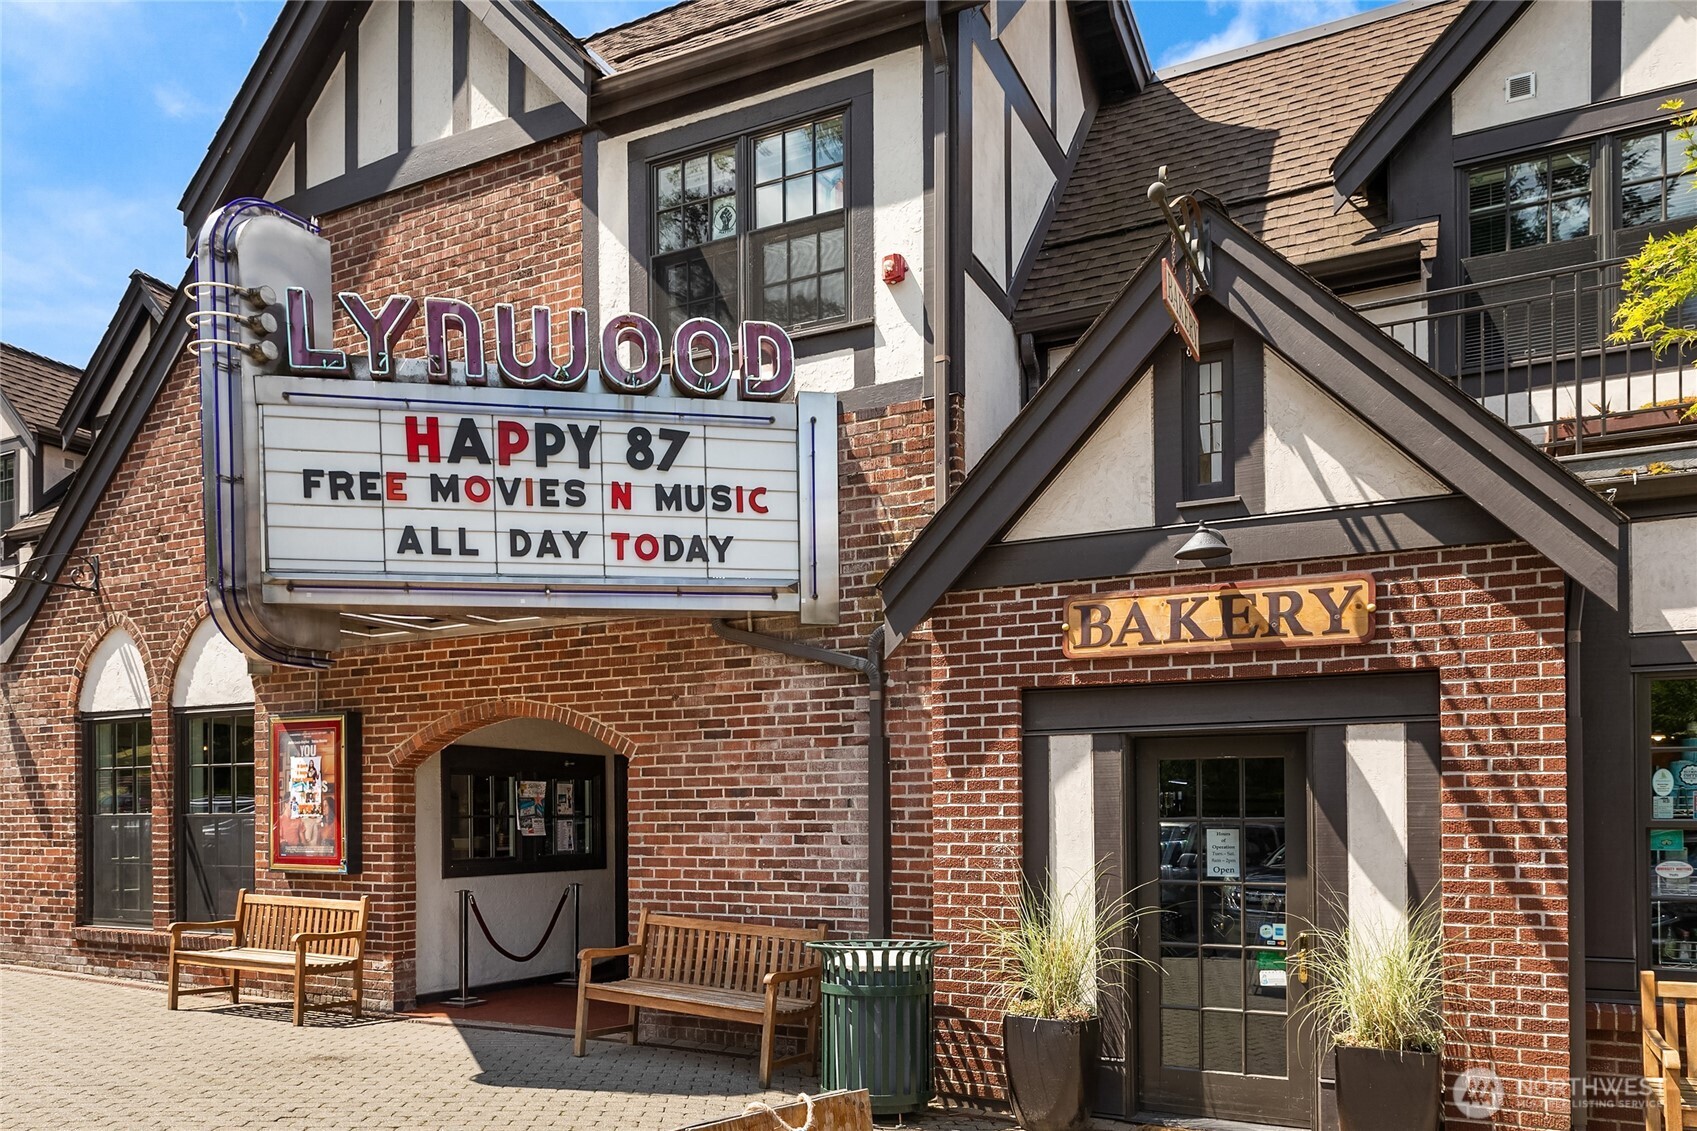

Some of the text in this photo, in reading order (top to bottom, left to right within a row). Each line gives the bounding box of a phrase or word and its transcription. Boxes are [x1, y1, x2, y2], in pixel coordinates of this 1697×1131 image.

[284, 286, 796, 400] LYNWOOD
[404, 415, 691, 472] HAPPY 87
[302, 468, 769, 514] FREE MOVIES N MUSIC
[397, 525, 735, 564] ALL DAY TODAY
[1072, 584, 1363, 649] BAKERY
[300, 744, 317, 757] YOU
[1213, 866, 1235, 875] Open
